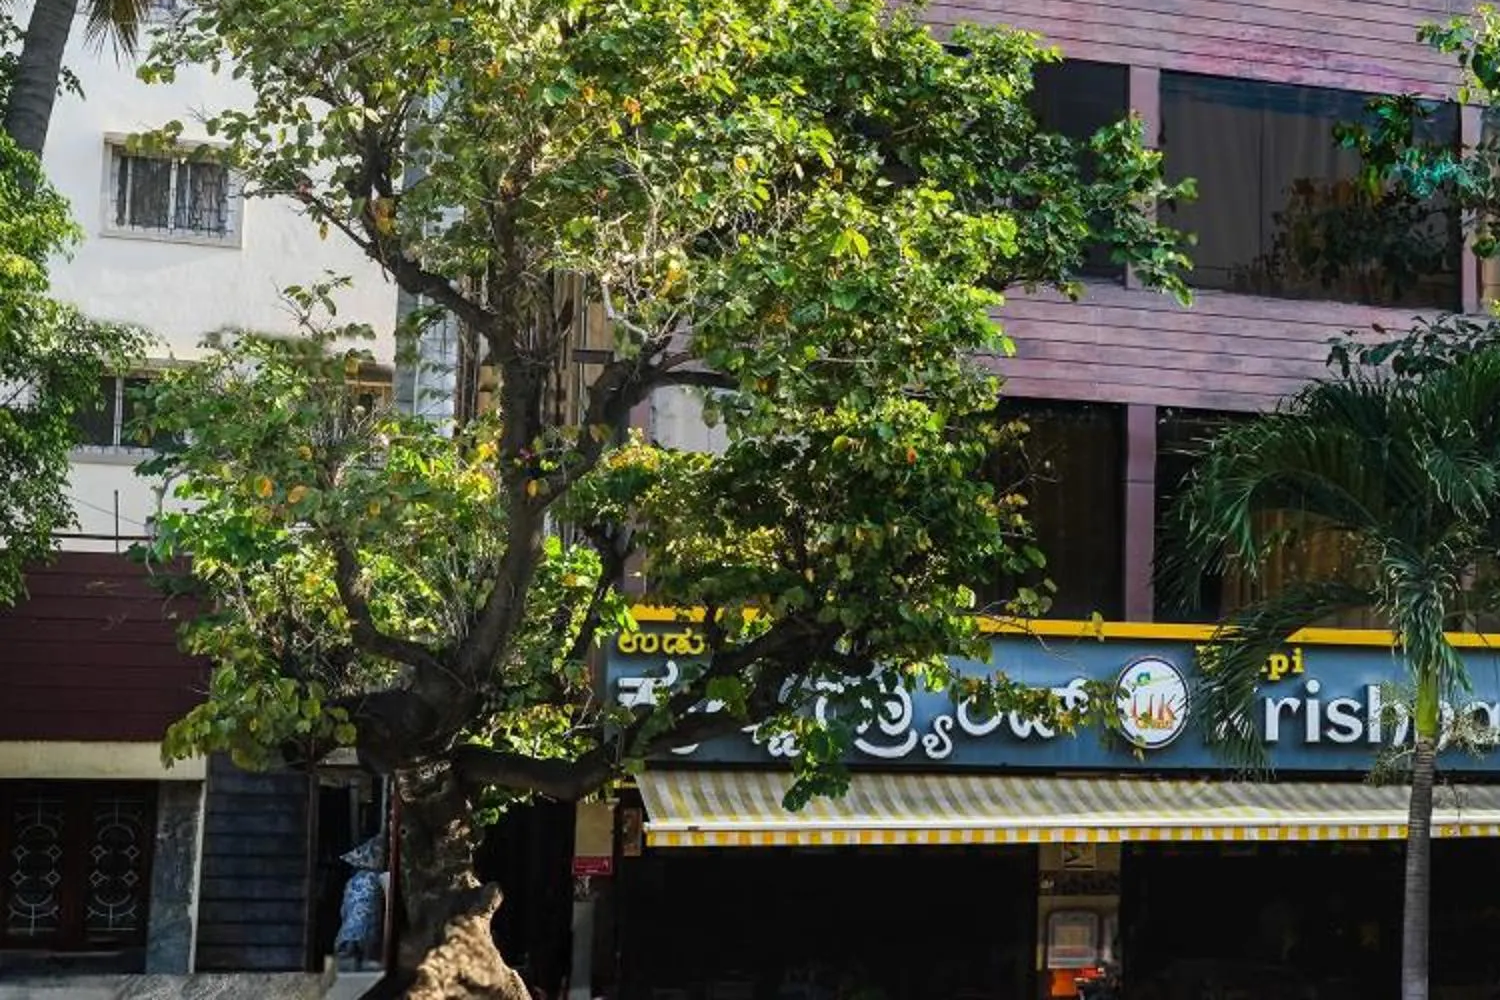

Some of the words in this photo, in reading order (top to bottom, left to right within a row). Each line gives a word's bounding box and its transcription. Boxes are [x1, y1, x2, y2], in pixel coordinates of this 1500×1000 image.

[618, 628, 708, 655] ಉಡು
[1195, 645, 1304, 681] Upi
[1212, 679, 1500, 751] risha
